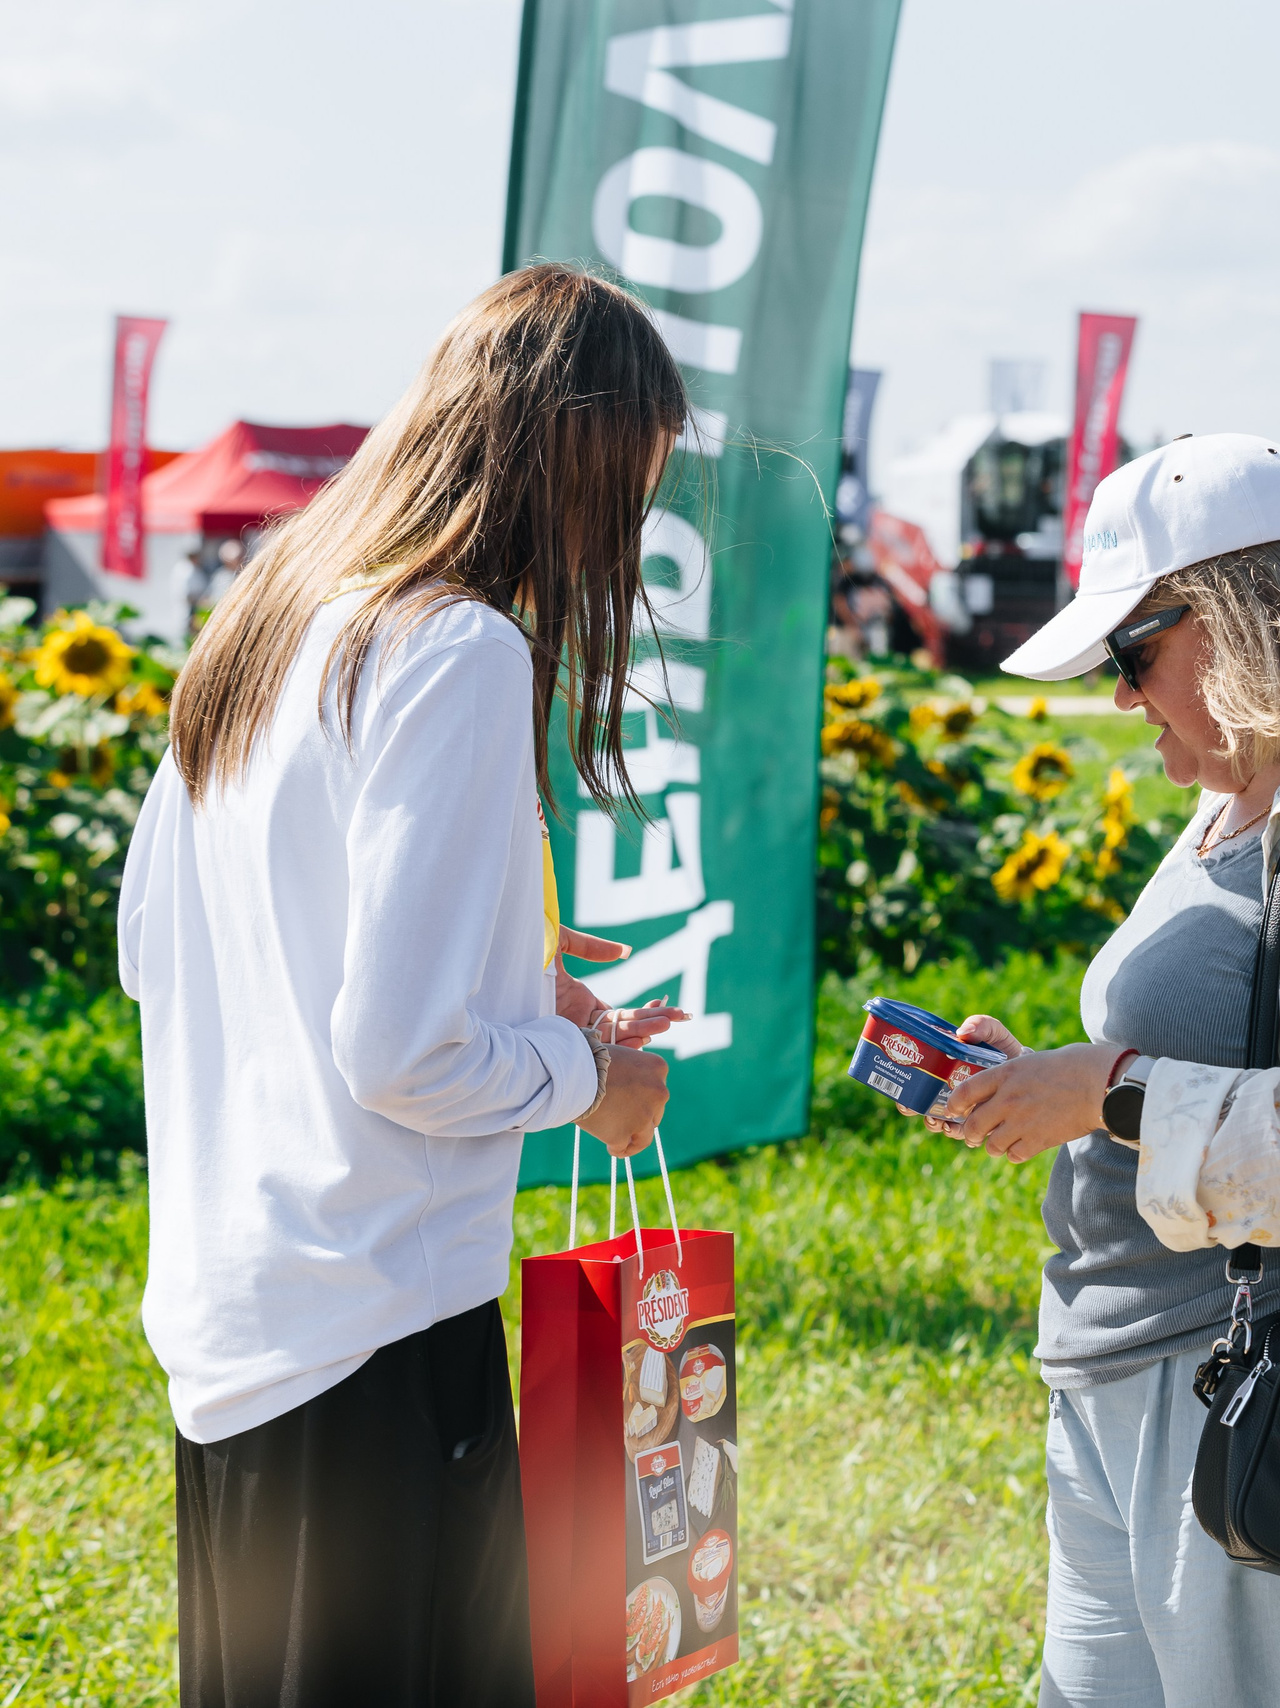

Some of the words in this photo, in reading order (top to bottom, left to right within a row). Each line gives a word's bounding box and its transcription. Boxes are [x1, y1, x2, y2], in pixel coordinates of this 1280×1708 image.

[881, 1035, 924, 1065] PRÉSIDENT
[873, 1054, 913, 1081] Сливочный
[637, 1290, 689, 1331] PRÉSIDENT
